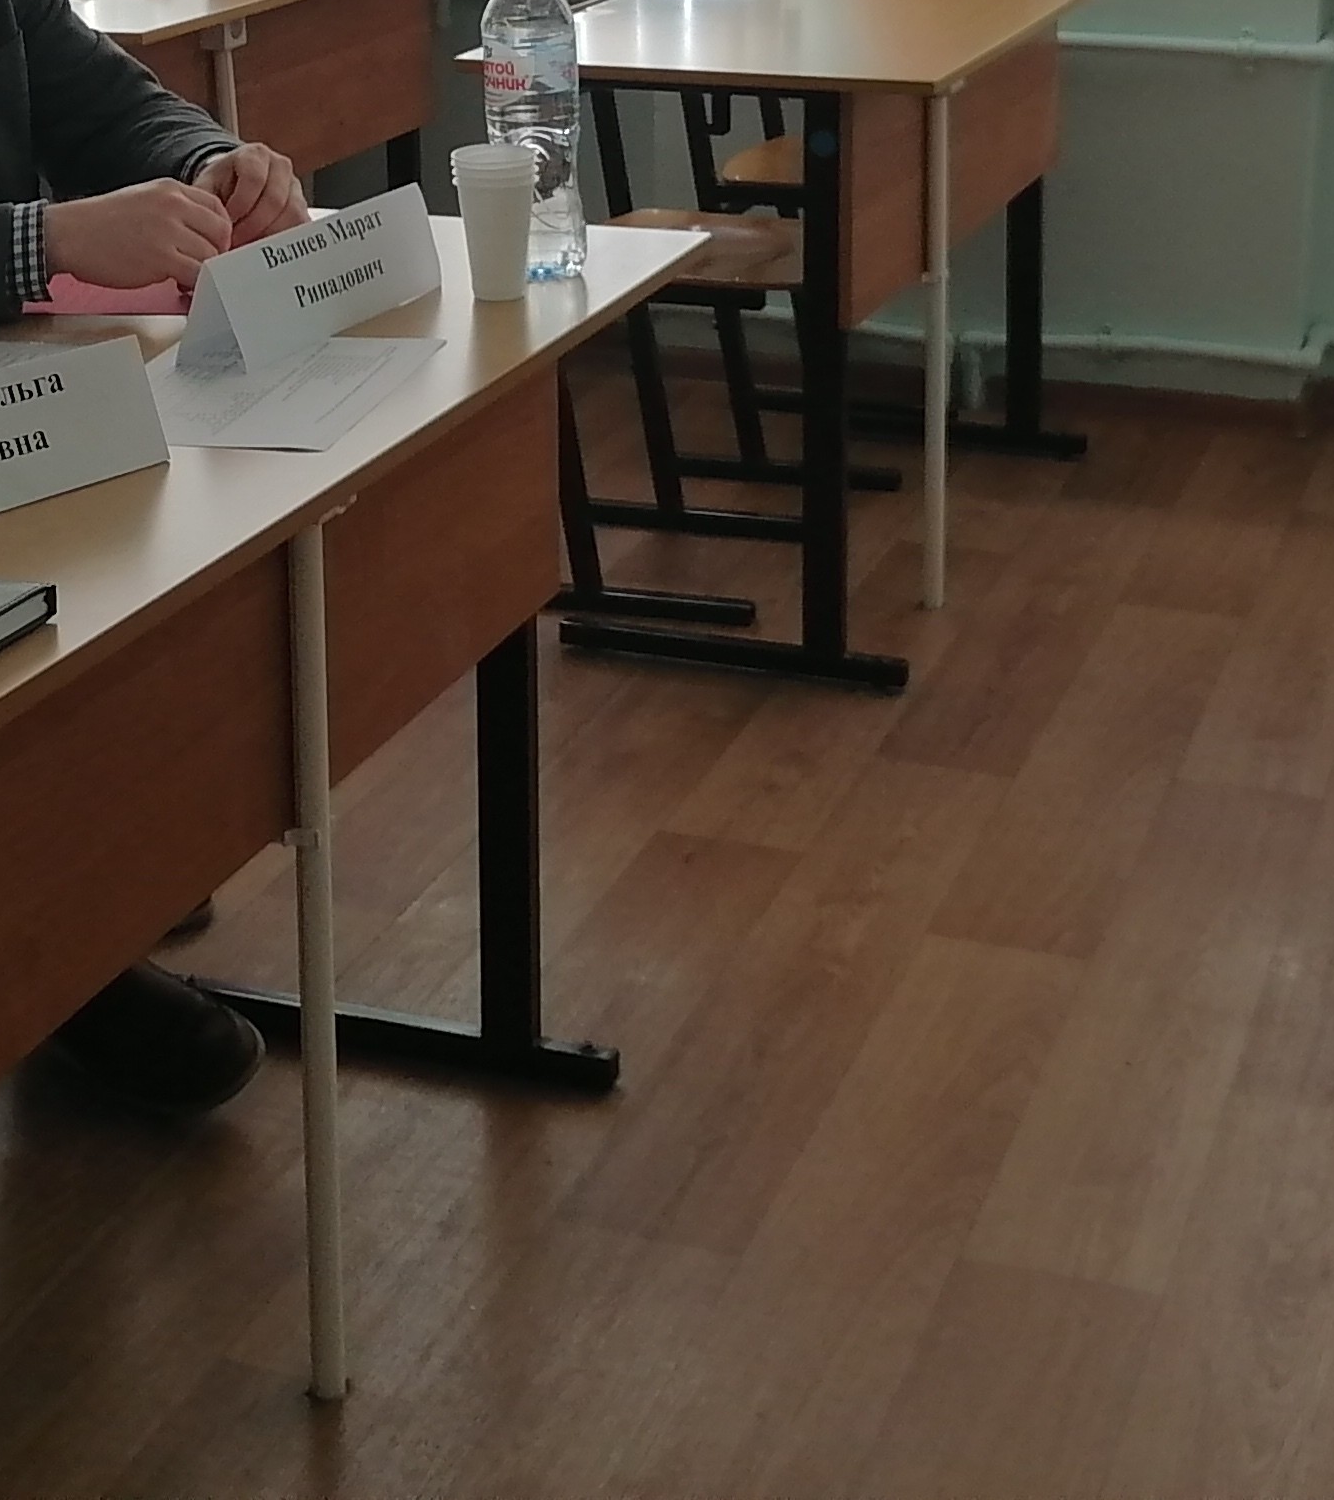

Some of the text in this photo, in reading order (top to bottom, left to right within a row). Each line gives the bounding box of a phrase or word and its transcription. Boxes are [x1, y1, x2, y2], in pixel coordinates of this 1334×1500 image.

[261, 211, 383, 269] Валиев Марат
[294, 259, 385, 308] Ринадович
